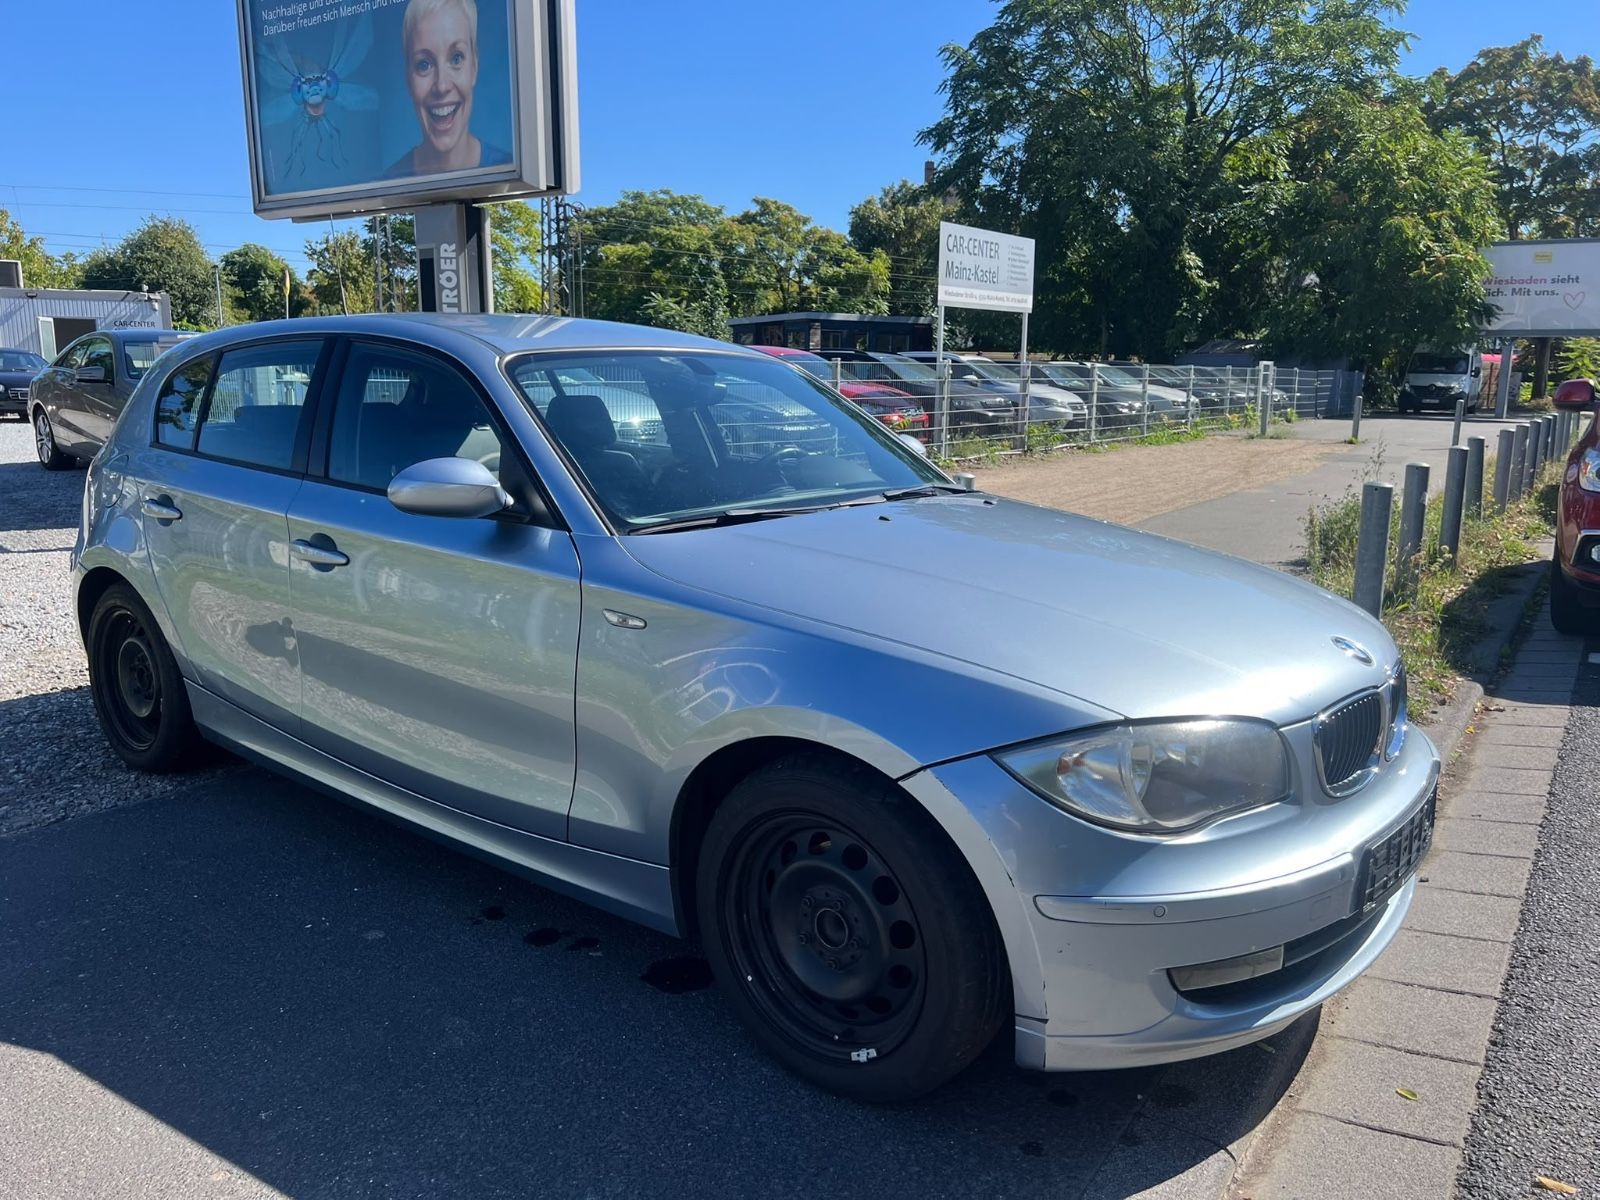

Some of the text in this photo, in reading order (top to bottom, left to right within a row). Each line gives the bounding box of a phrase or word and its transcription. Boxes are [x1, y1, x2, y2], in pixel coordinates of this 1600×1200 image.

[262, 2, 307, 20] Nachhaltige
[263, 20, 296, 36] Darüber
[297, 14, 322, 29] freuen
[322, 7, 339, 22] sich
[339, 1, 371, 17] Mensch
[946, 234, 999, 259] CAR-CENTER
[945, 260, 999, 284] Mainz-Kastel
[1483, 274, 1580, 285] Wiesbaden sieht
[1511, 287, 1532, 297] Mit
[113, 320, 155, 328] CAR-CENTER
